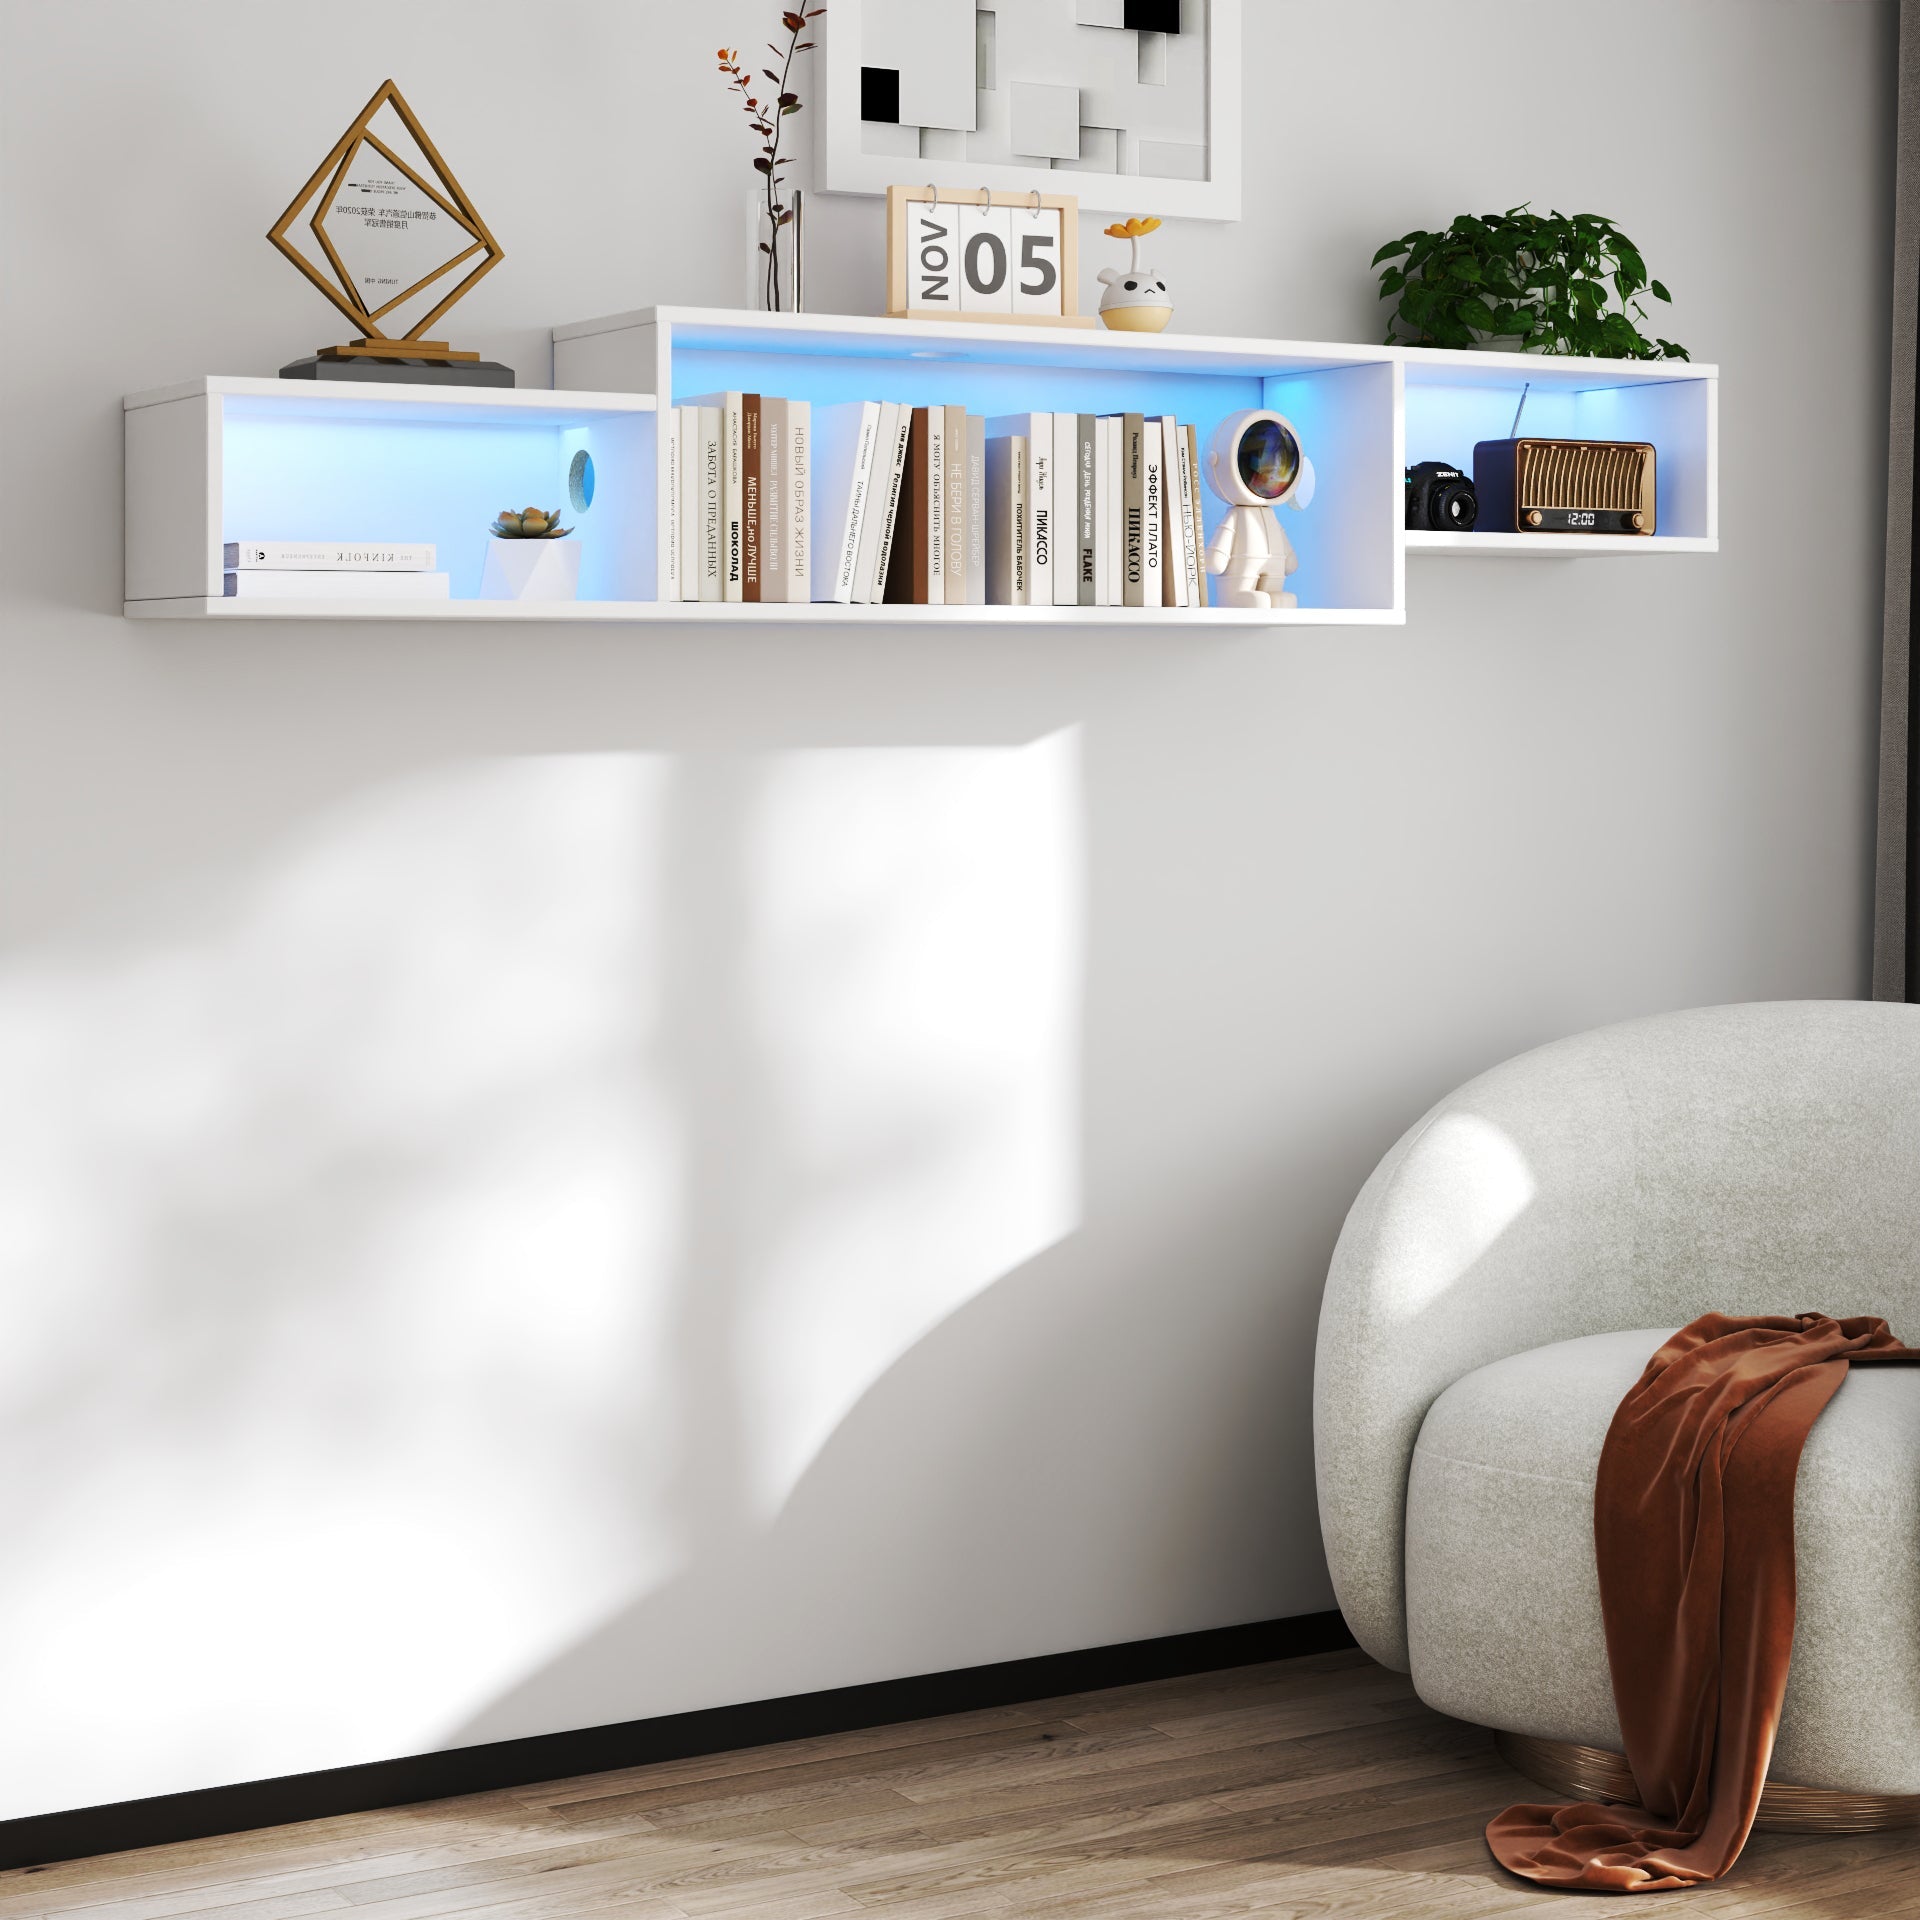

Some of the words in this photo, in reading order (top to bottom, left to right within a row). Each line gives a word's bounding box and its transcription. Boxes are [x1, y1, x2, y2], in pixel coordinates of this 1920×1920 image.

[920, 218, 949, 300] NOV
[707, 441, 717, 485] ЗАБОТА
[794, 427, 805, 476] НОВЫЙ
[933, 444, 941, 470] МОГУ
[951, 464, 962, 478] НЕ
[970, 455, 980, 486] ДАВИД
[708, 490, 717, 498] О
[794, 480, 804, 523] ОБРАЗ
[889, 473, 901, 508] Религия
[933, 474, 941, 532] ОБЪЯСНИТЬ
[951, 482, 962, 513] БЕРИ
[1148, 464, 1158, 518] ЭФФЕКТ
[706, 502, 717, 578] ПРЕДАННЫХ
[951, 516, 962, 524] В
[971, 487, 980, 567] СЕРВАН-ШРЕЙБЕР
[1036, 510, 1048, 565] ПИКАССО
[1568, 512, 1595, 526] 12:00
[730, 521, 739, 582] ШОКОЛАД
[747, 544, 757, 583] ЛУЧШЕ
[794, 527, 804, 577] ЖИЗНИ
[877, 541, 889, 586] водолазки
[933, 535, 941, 576] МНОГОЕ
[950, 528, 962, 577] ГОЛОВУ
[1082, 548, 1092, 582] FLAKE
[1128, 507, 1140, 583] ПИКАССО
[1148, 523, 1158, 568] ПЛАТО
[1183, 504, 1198, 587] НЬЮ-ЙОРК
[842, 550, 854, 587] ВОСТОКА
